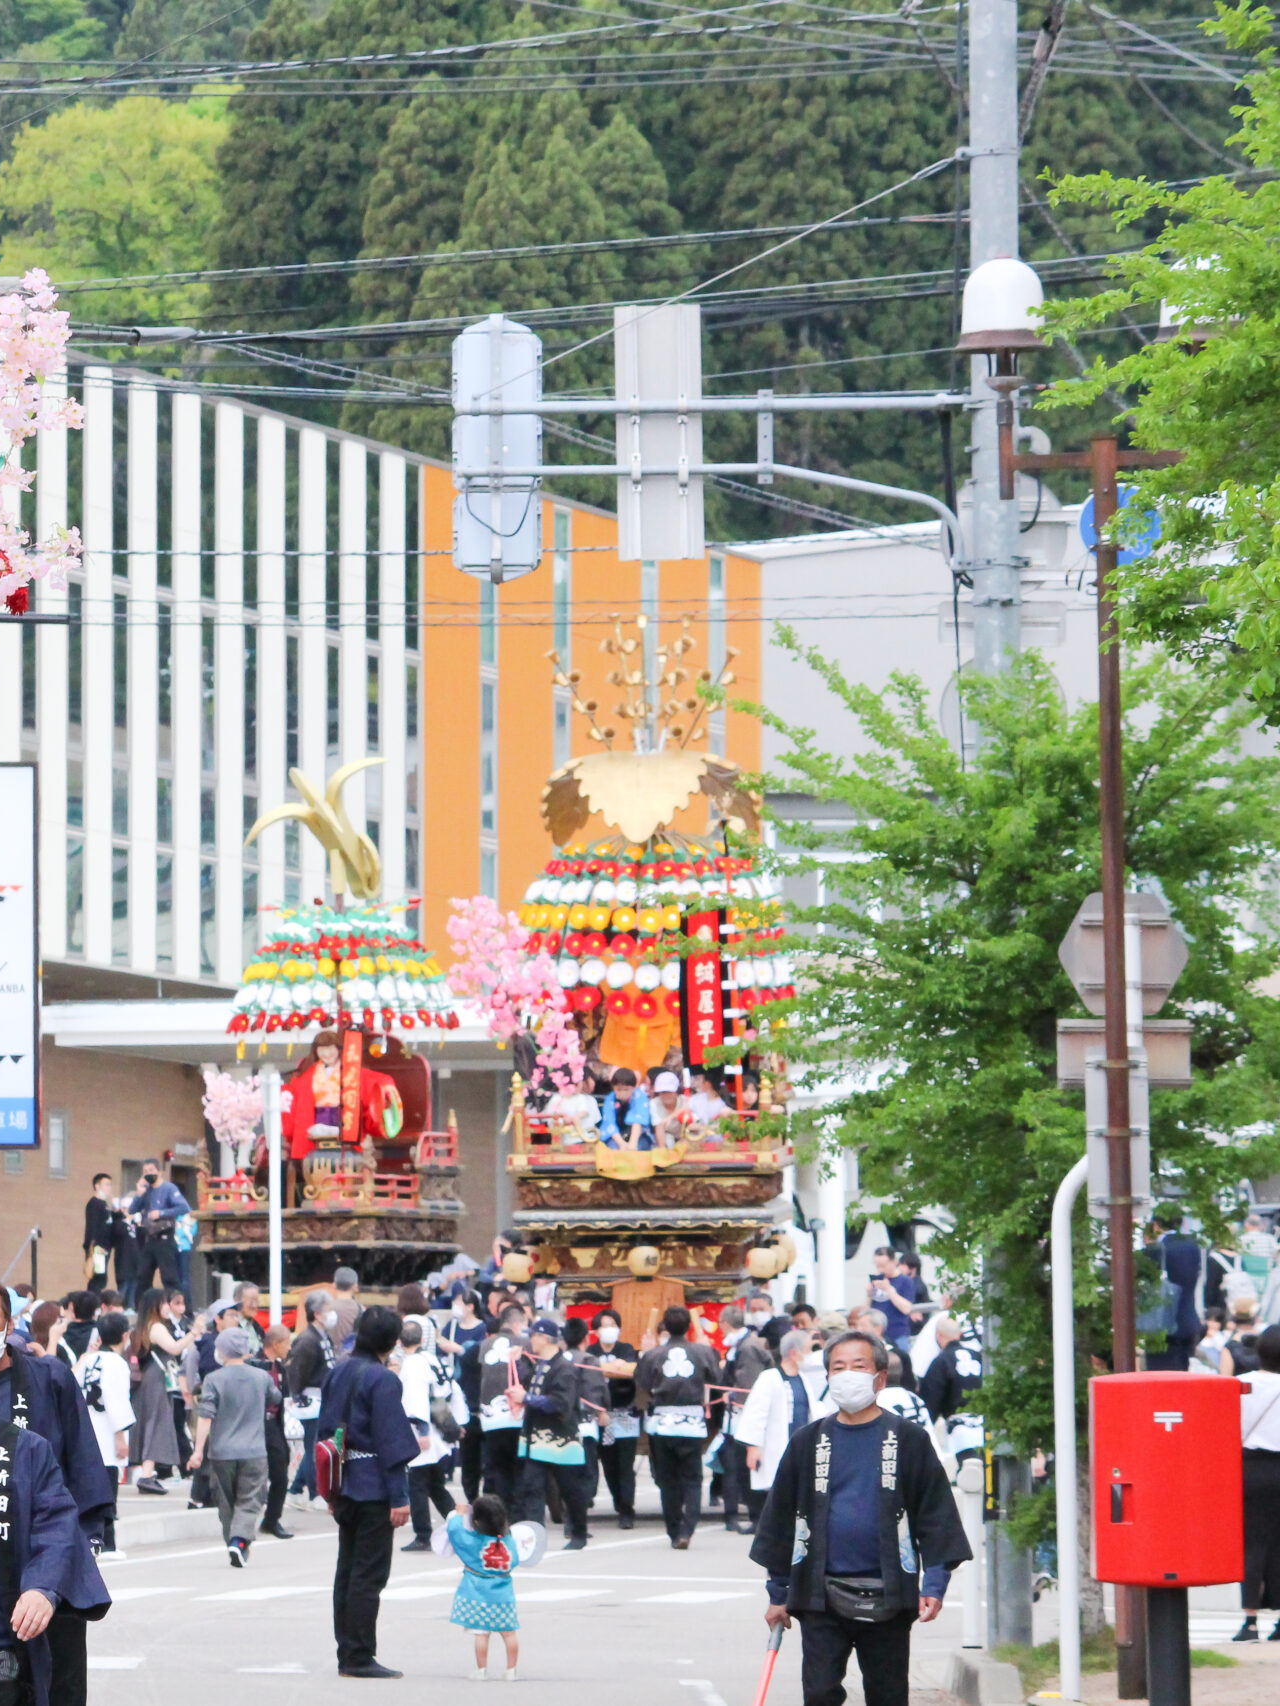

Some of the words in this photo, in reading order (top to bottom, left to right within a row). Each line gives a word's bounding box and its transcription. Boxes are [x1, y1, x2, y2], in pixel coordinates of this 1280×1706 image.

[815, 1433, 832, 1493] 上新田町
[881, 1430, 898, 1490] 上新田町
